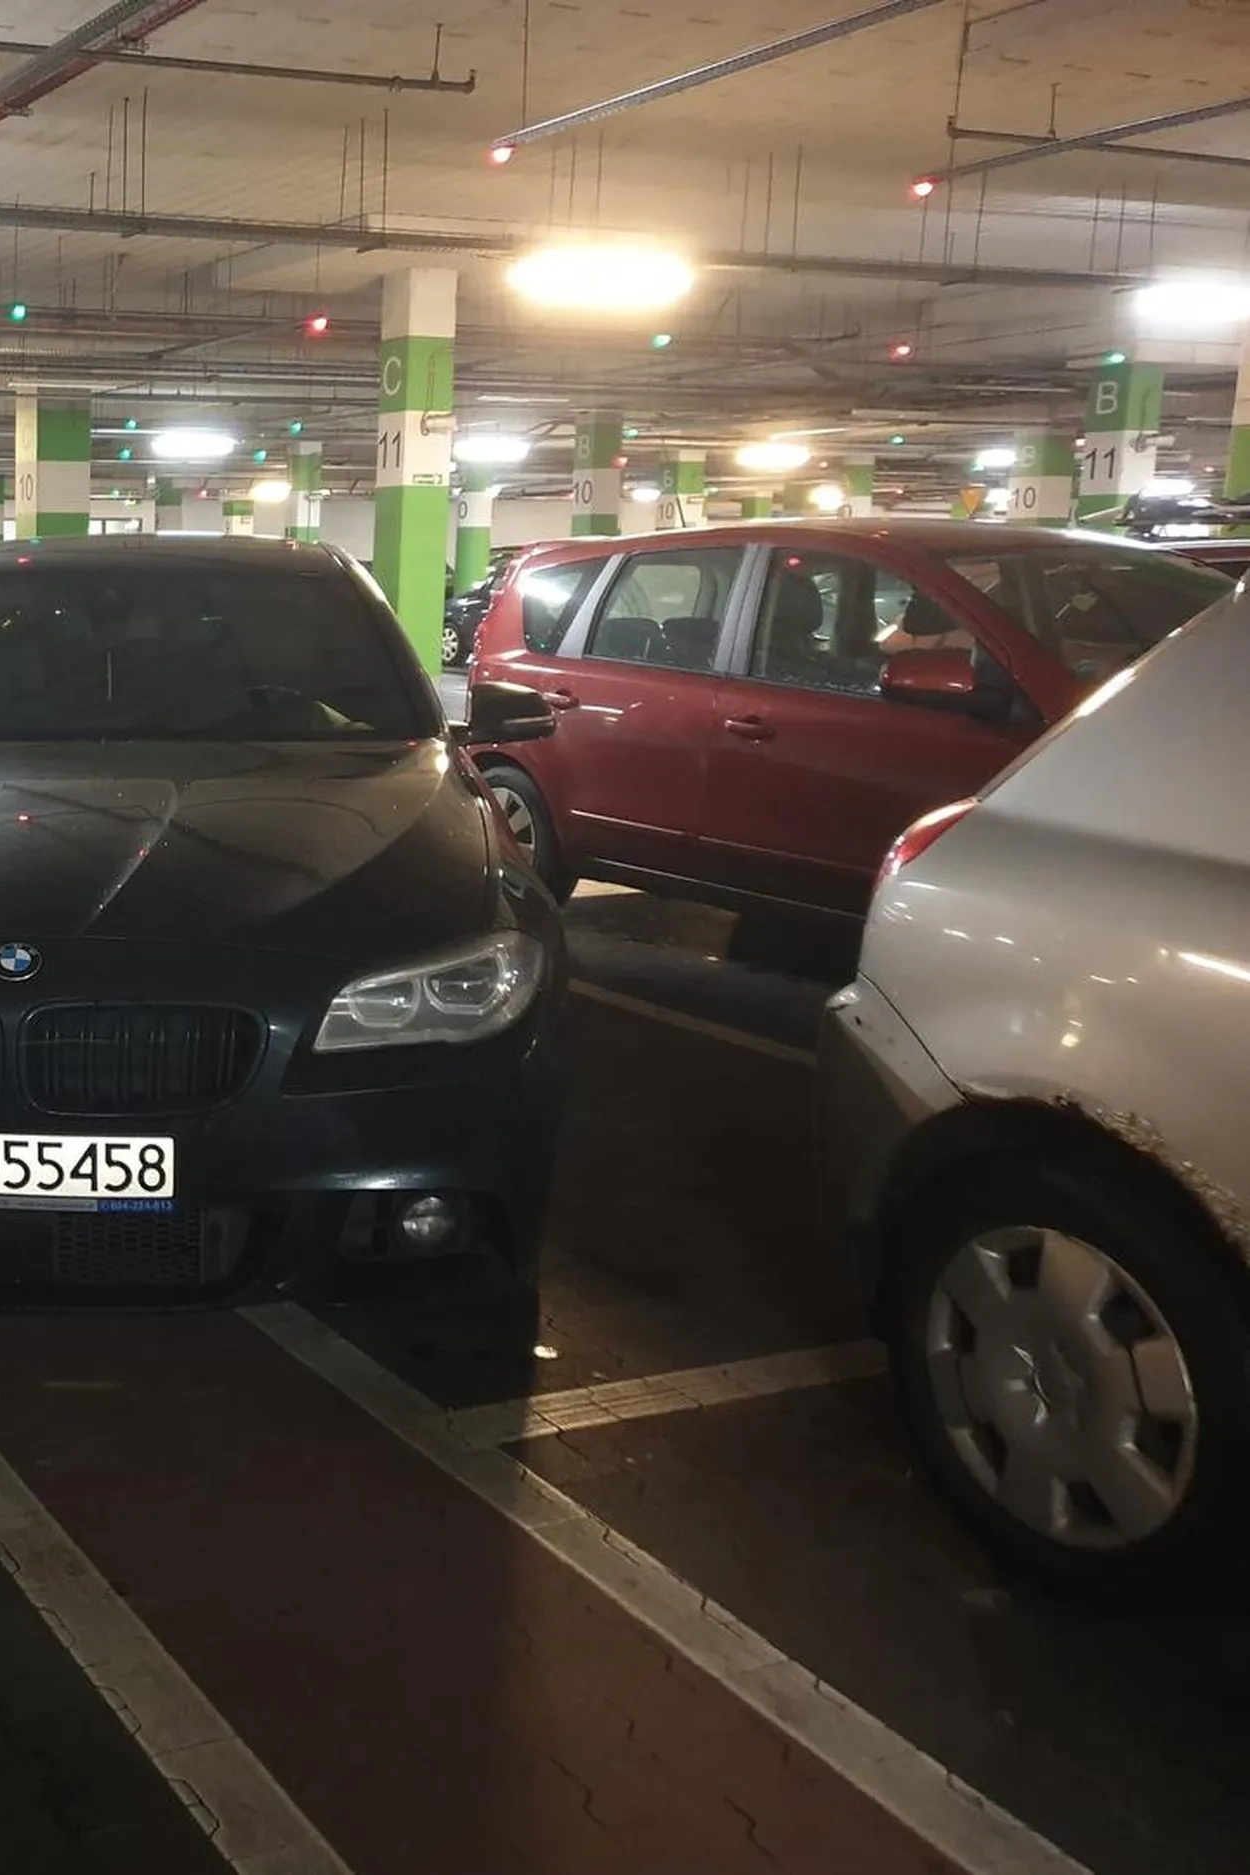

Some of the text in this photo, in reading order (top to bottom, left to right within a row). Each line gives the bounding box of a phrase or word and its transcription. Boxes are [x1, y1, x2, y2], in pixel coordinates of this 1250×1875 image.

[383, 356, 402, 396] C
[1096, 381, 1120, 415] B
[379, 431, 401, 469] 11
[1085, 447, 1116, 480] 11
[20, 473, 34, 501] 10
[574, 480, 593, 504] 10
[1011, 486, 1036, 509] 10
[659, 502, 675, 520] 10
[3, 1140, 166, 1192] 55458
